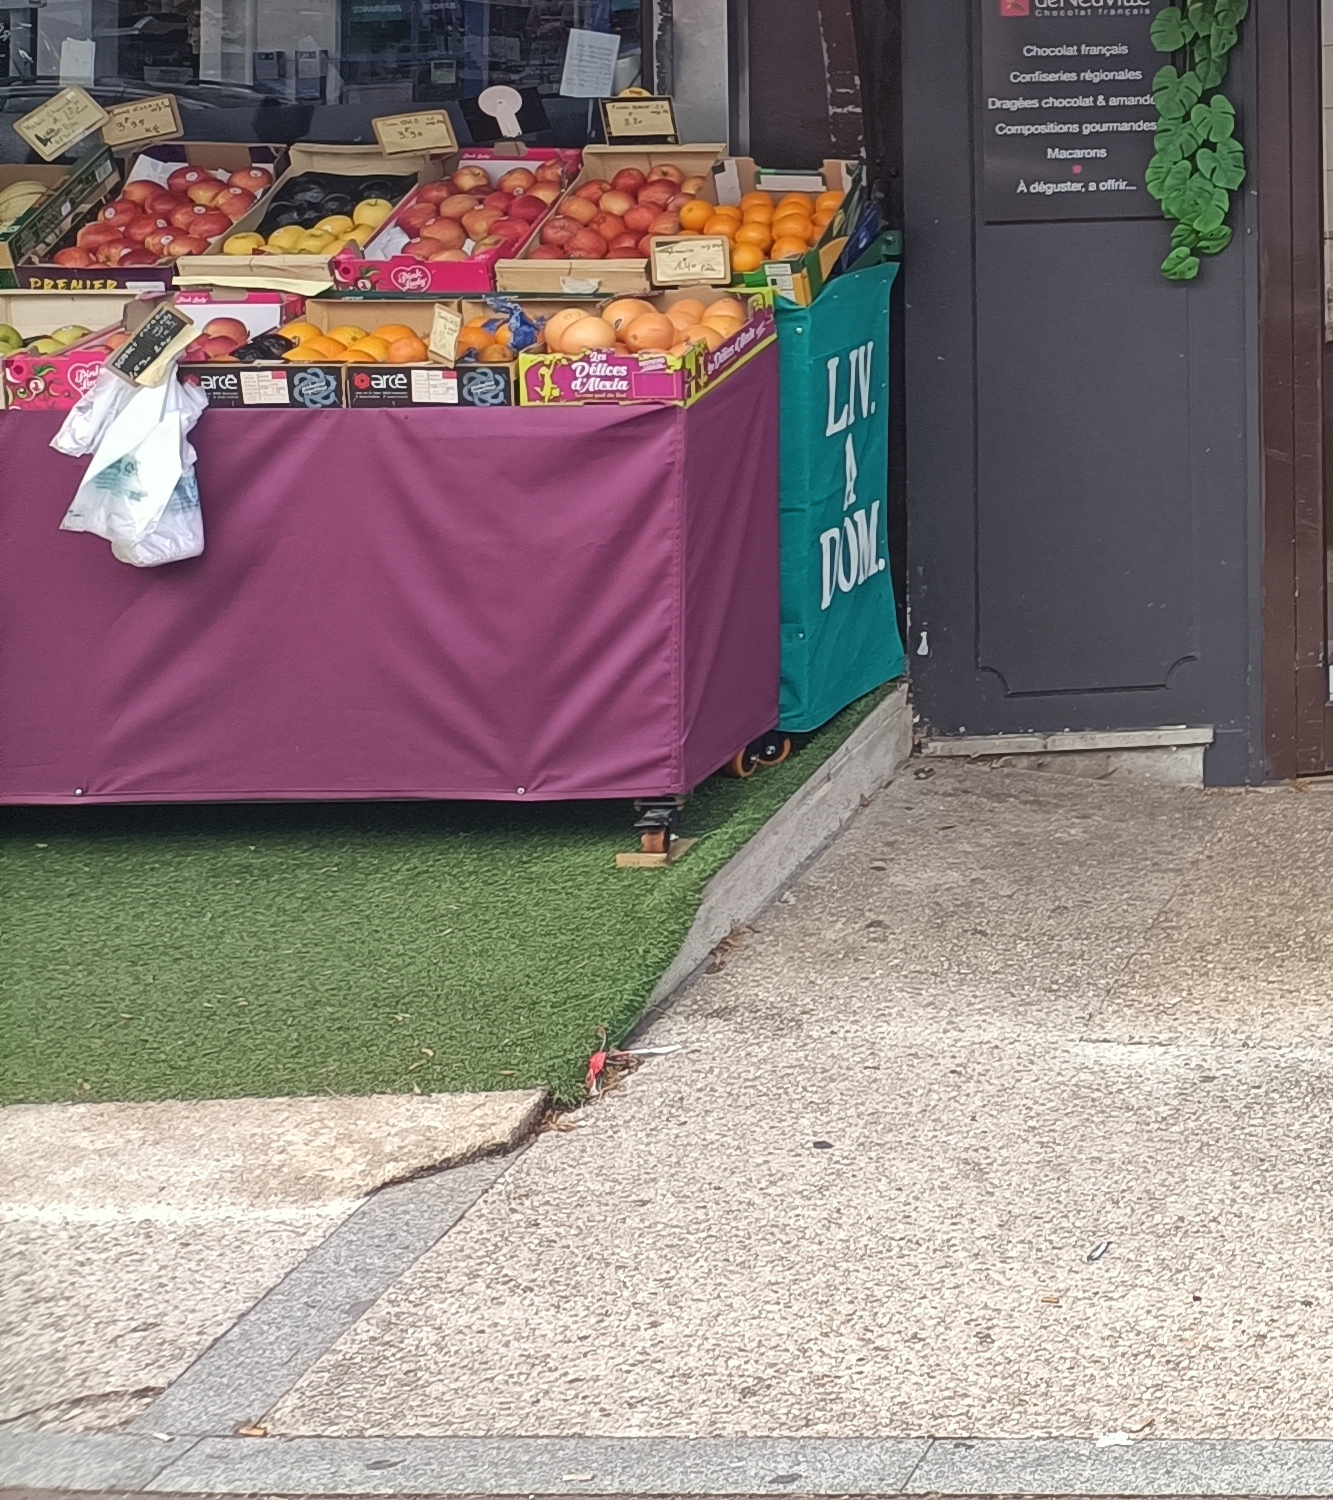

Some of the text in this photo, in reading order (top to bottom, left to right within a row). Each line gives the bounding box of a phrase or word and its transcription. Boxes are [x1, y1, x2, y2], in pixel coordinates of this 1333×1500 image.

[1022, 42, 1129, 57] Chocolat français
[1010, 69, 1143, 84] Confiseries régionales
[988, 97, 1039, 111] Dragées
[1041, 95, 1095, 108] chocolat
[1096, 95, 1106, 106] &
[995, 119, 1158, 136] Compositions gourmandes
[1047, 147, 1107, 159] Macarons
[570, 361, 628, 378] Délices
[825, 340, 876, 437] LIV.
[842, 432, 858, 512] A
[820, 500, 886, 611] DOM.
